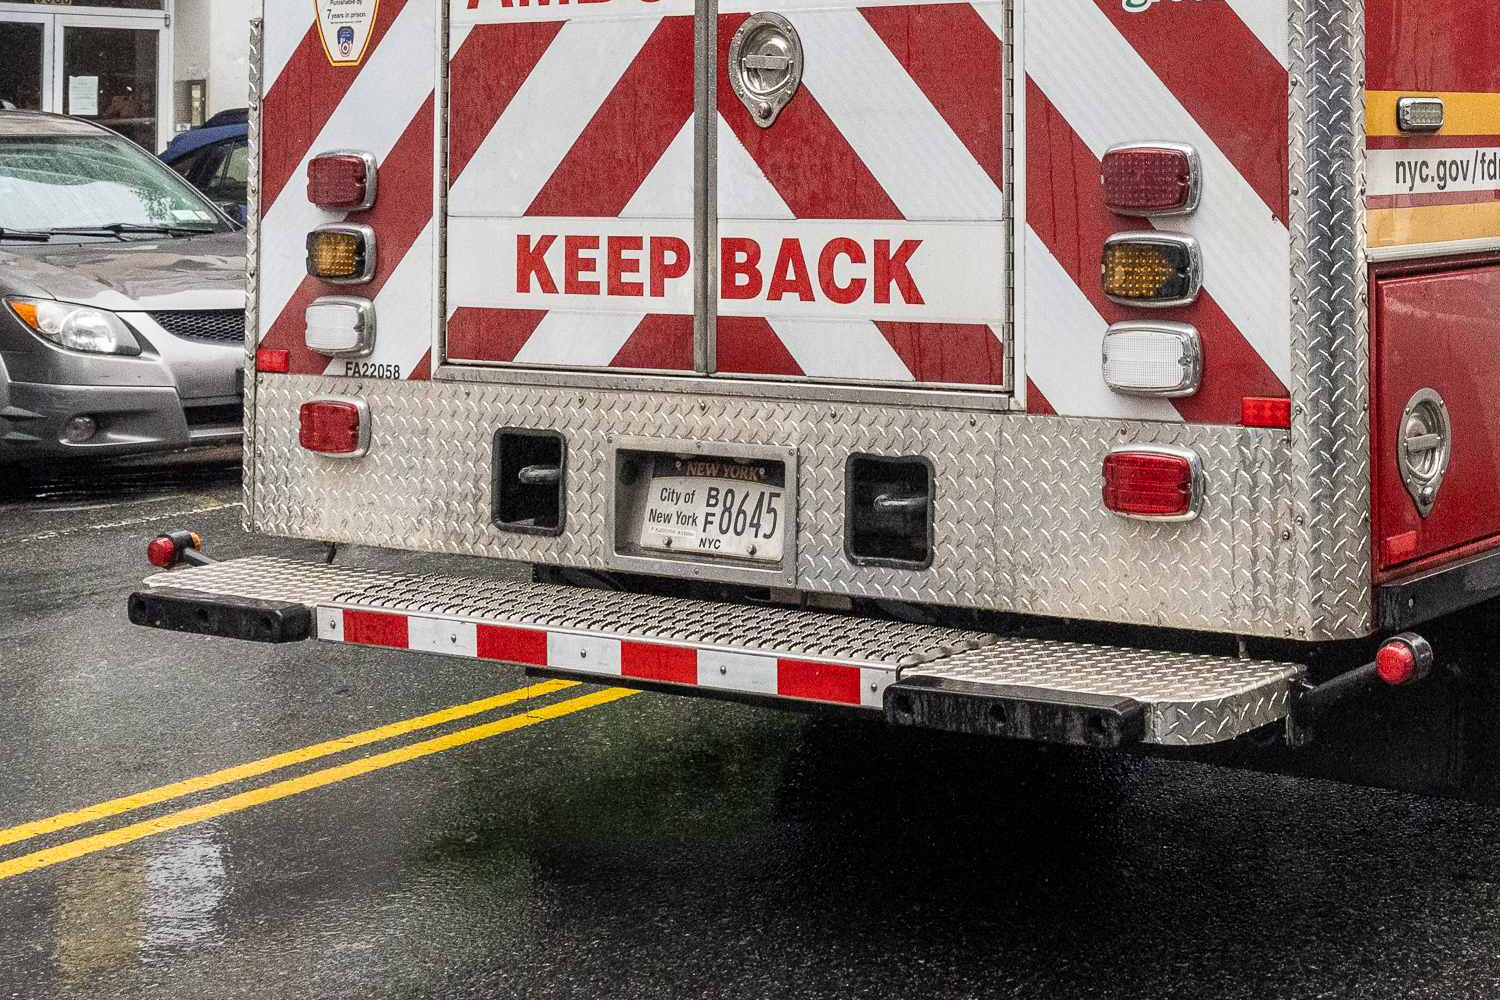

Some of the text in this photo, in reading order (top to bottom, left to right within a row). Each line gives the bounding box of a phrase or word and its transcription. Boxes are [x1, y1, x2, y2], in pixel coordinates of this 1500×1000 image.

[327, 9, 332, 19] 7
[516, 234, 925, 305] KEEP BACK
[346, 362, 400, 380] FA22058
[686, 462, 759, 481] NEW YORK
[660, 488, 696, 505] City of
[649, 509, 698, 527] New York
[719, 489, 781, 540] 8645
[699, 538, 721, 550] NYC
